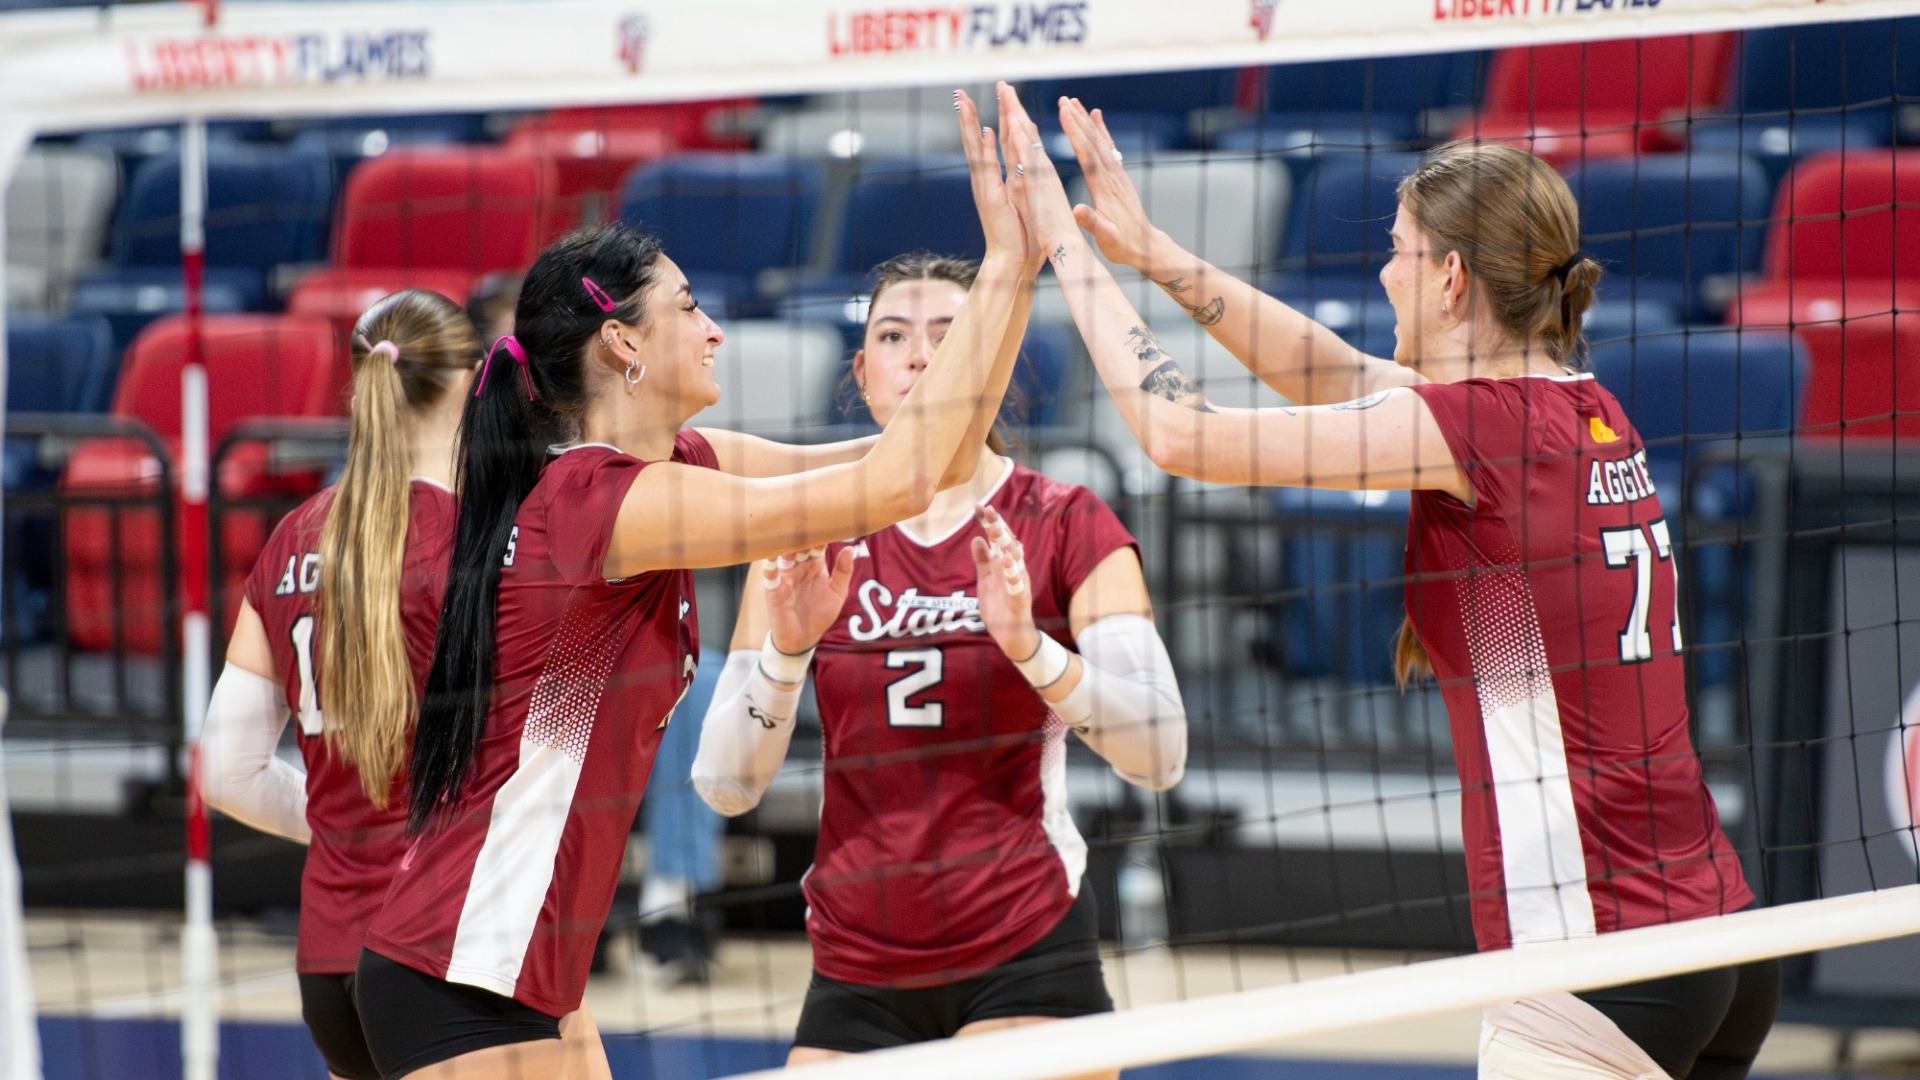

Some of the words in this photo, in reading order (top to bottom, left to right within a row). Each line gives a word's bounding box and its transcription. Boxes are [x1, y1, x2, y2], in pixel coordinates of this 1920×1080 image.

[1586, 450, 1656, 504] AGGIE
[848, 579, 986, 641] State
[885, 646, 944, 728] 2
